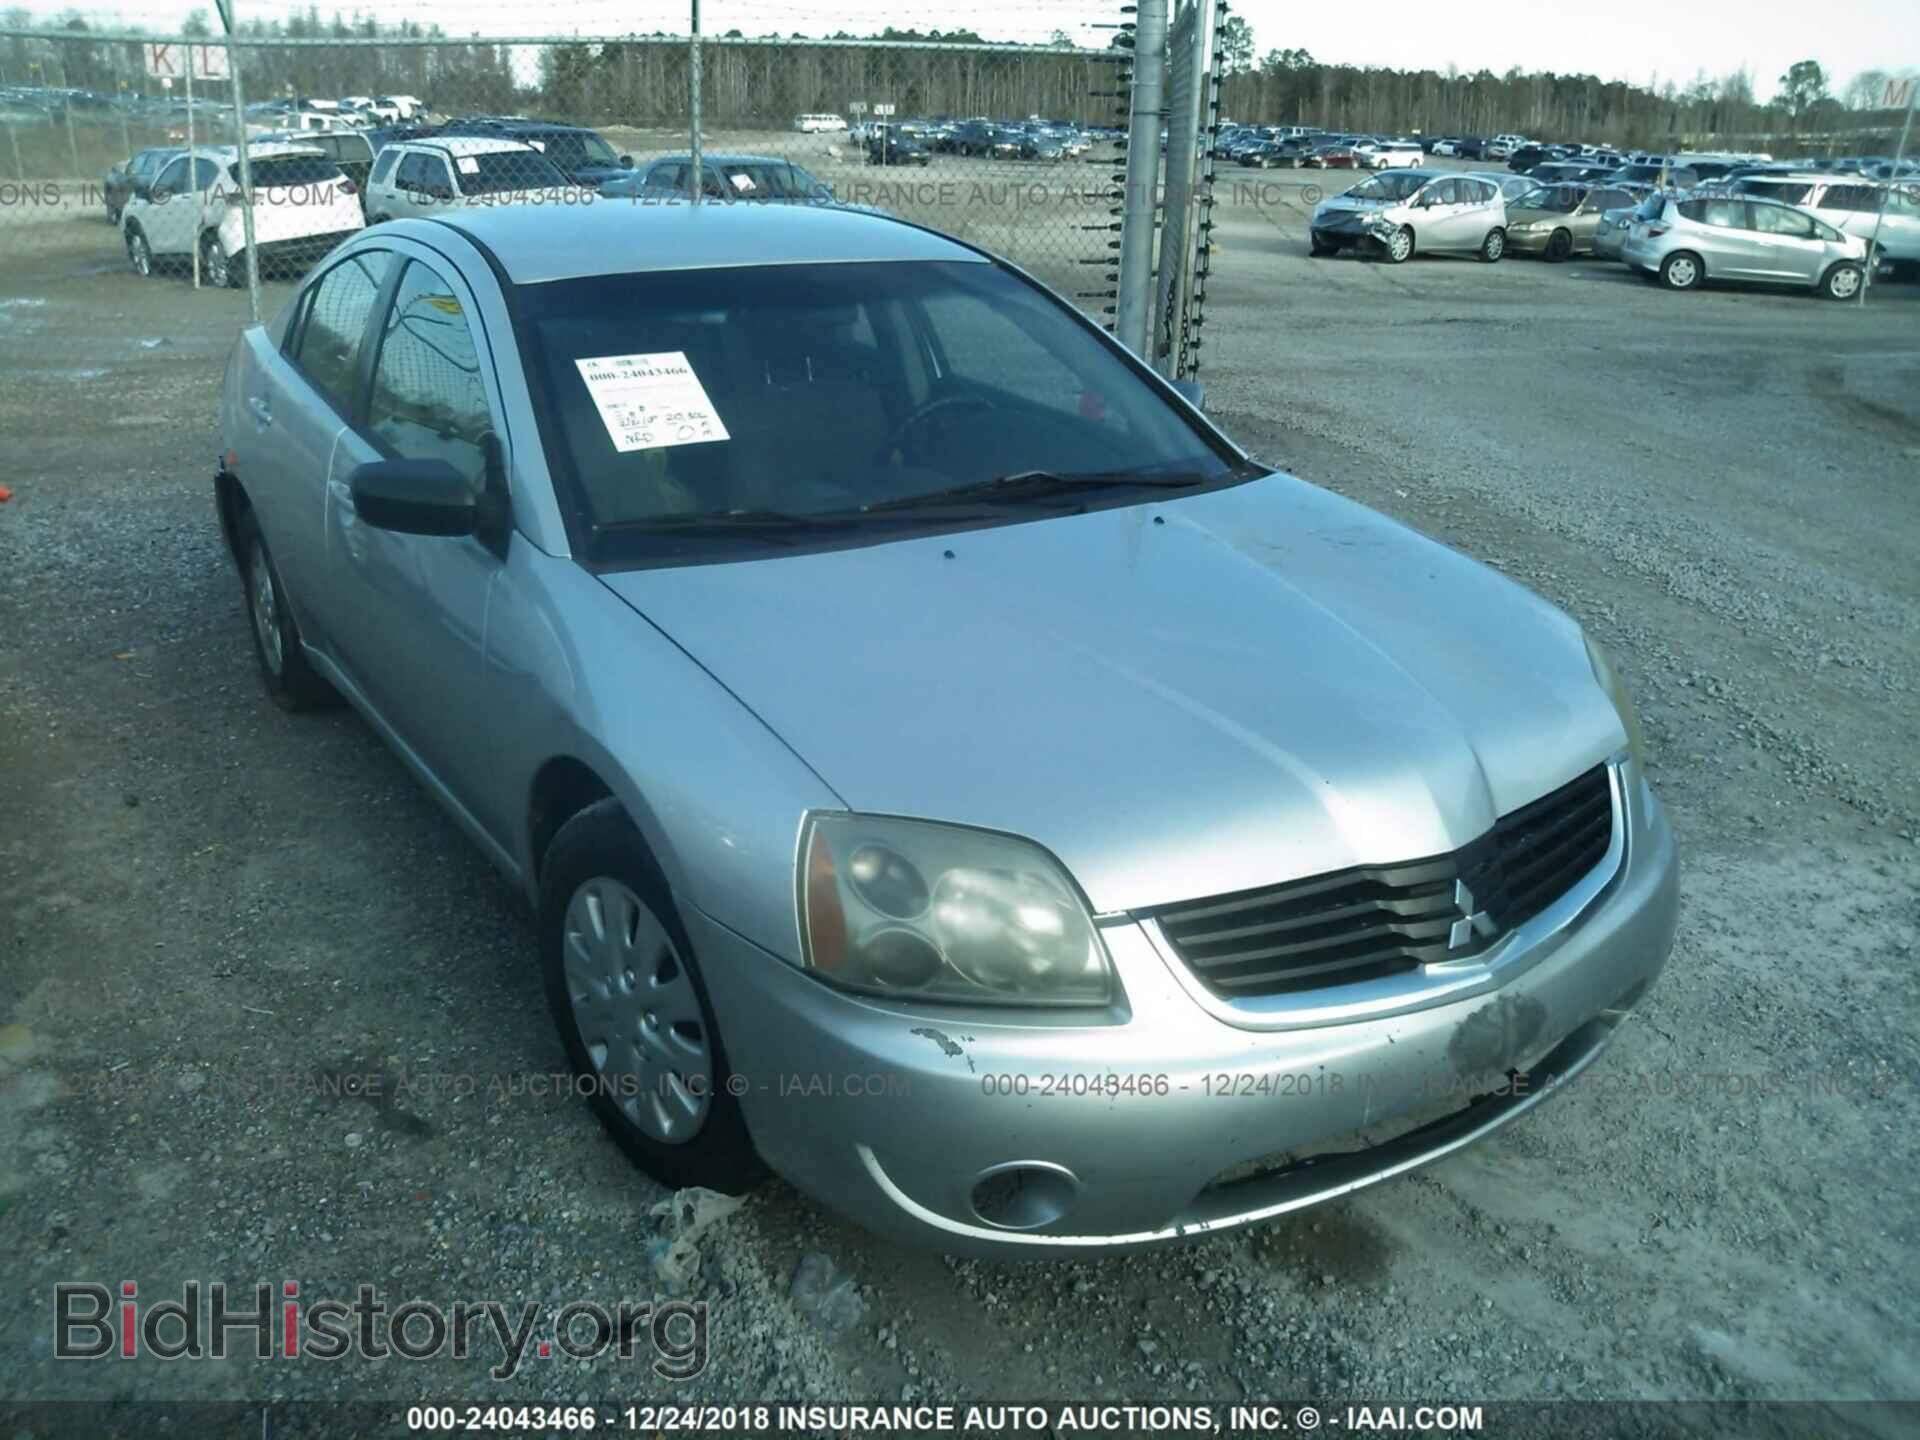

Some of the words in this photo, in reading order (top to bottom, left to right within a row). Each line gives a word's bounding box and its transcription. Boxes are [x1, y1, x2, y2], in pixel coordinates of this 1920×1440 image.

[151, 43, 175, 74] K
[203, 44, 220, 76] L
[1882, 80, 1909, 106] M
